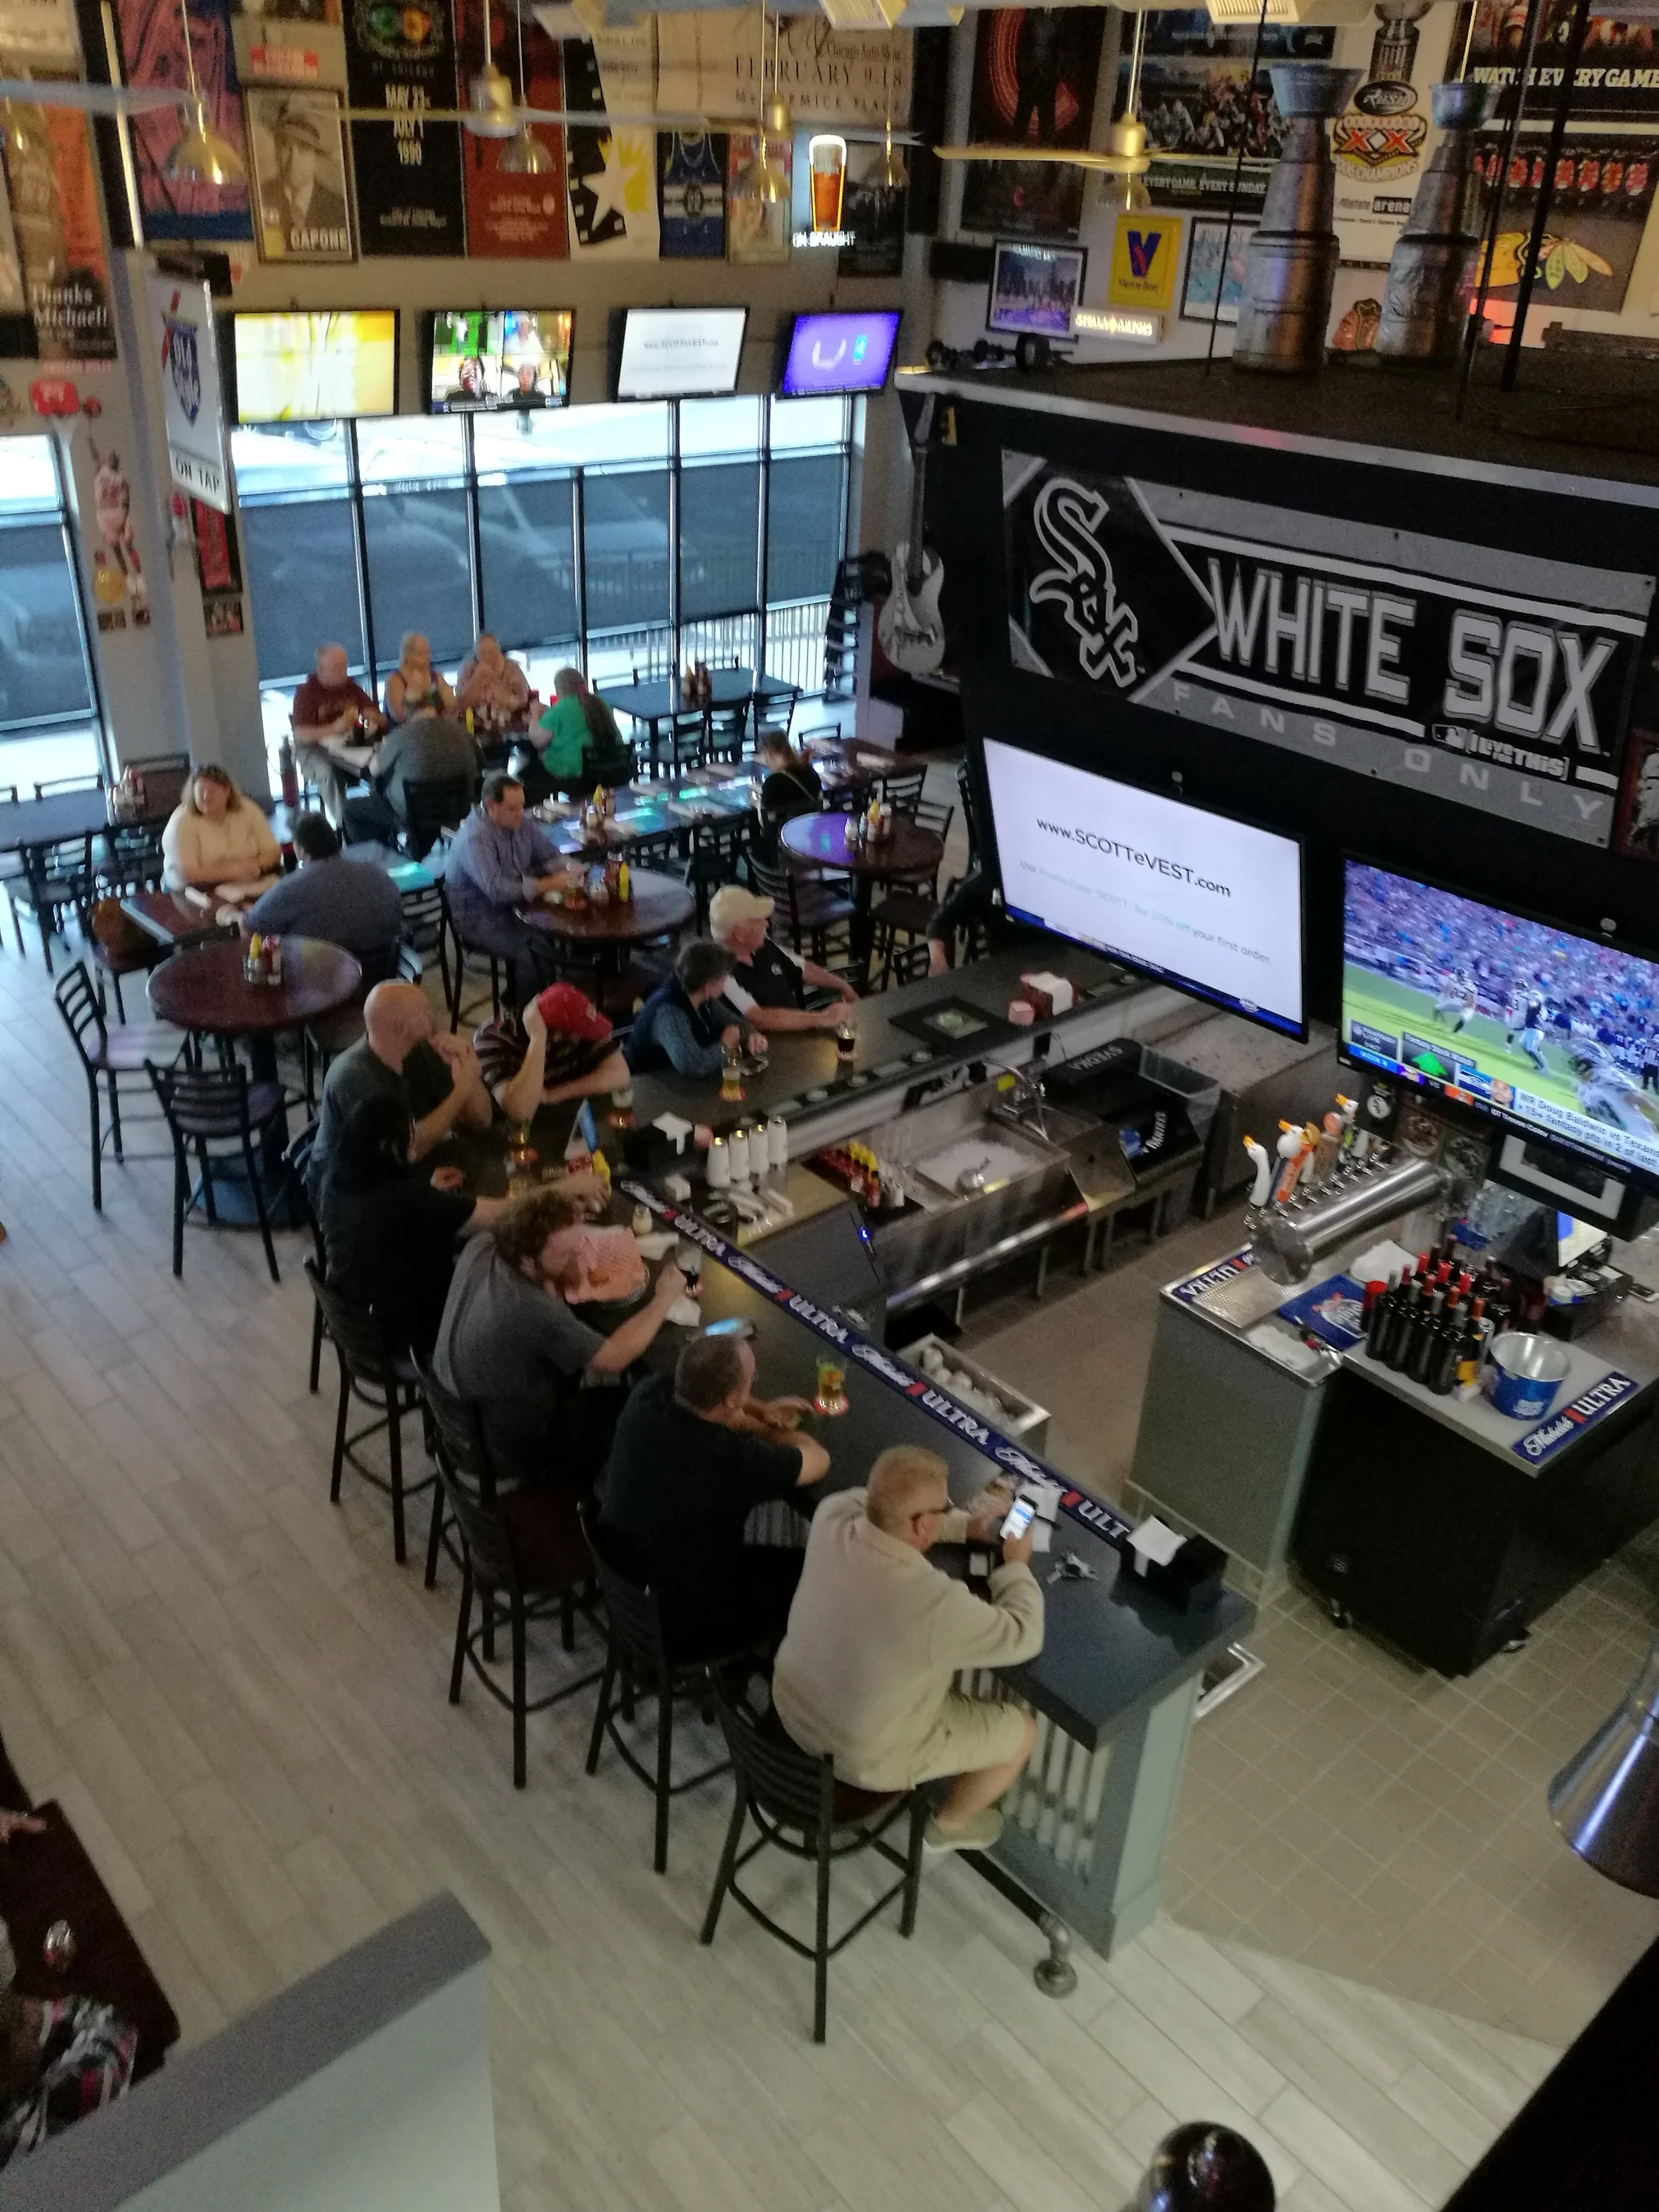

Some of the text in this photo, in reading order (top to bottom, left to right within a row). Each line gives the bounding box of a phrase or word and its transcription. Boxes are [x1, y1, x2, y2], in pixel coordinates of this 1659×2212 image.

[1538, 68, 1606, 86] EVRY
[1354, 158, 1419, 183] CHAMPIONS
[1374, 200, 1411, 213] arena
[291, 227, 347, 251] CAPONE
[199, 467, 220, 494] TAP
[1208, 556, 1619, 755] WHITE SOX
[1173, 679, 1603, 821] FANS ONLY
[1037, 818, 1231, 898] www.SCOTTeVEST.com
[1191, 928, 1216, 944] your
[1217, 936, 1240, 954] first
[1537, 1099, 1564, 1120] Doug
[674, 1214, 727, 1256] ULTRA
[1179, 1264, 1241, 1297] ULTRA
[789, 1293, 850, 1344] ULTRA
[1571, 1376, 1632, 1416] ULTRA
[921, 1388, 990, 1446] ULTRA
[1078, 1499, 1131, 1540] ULT
